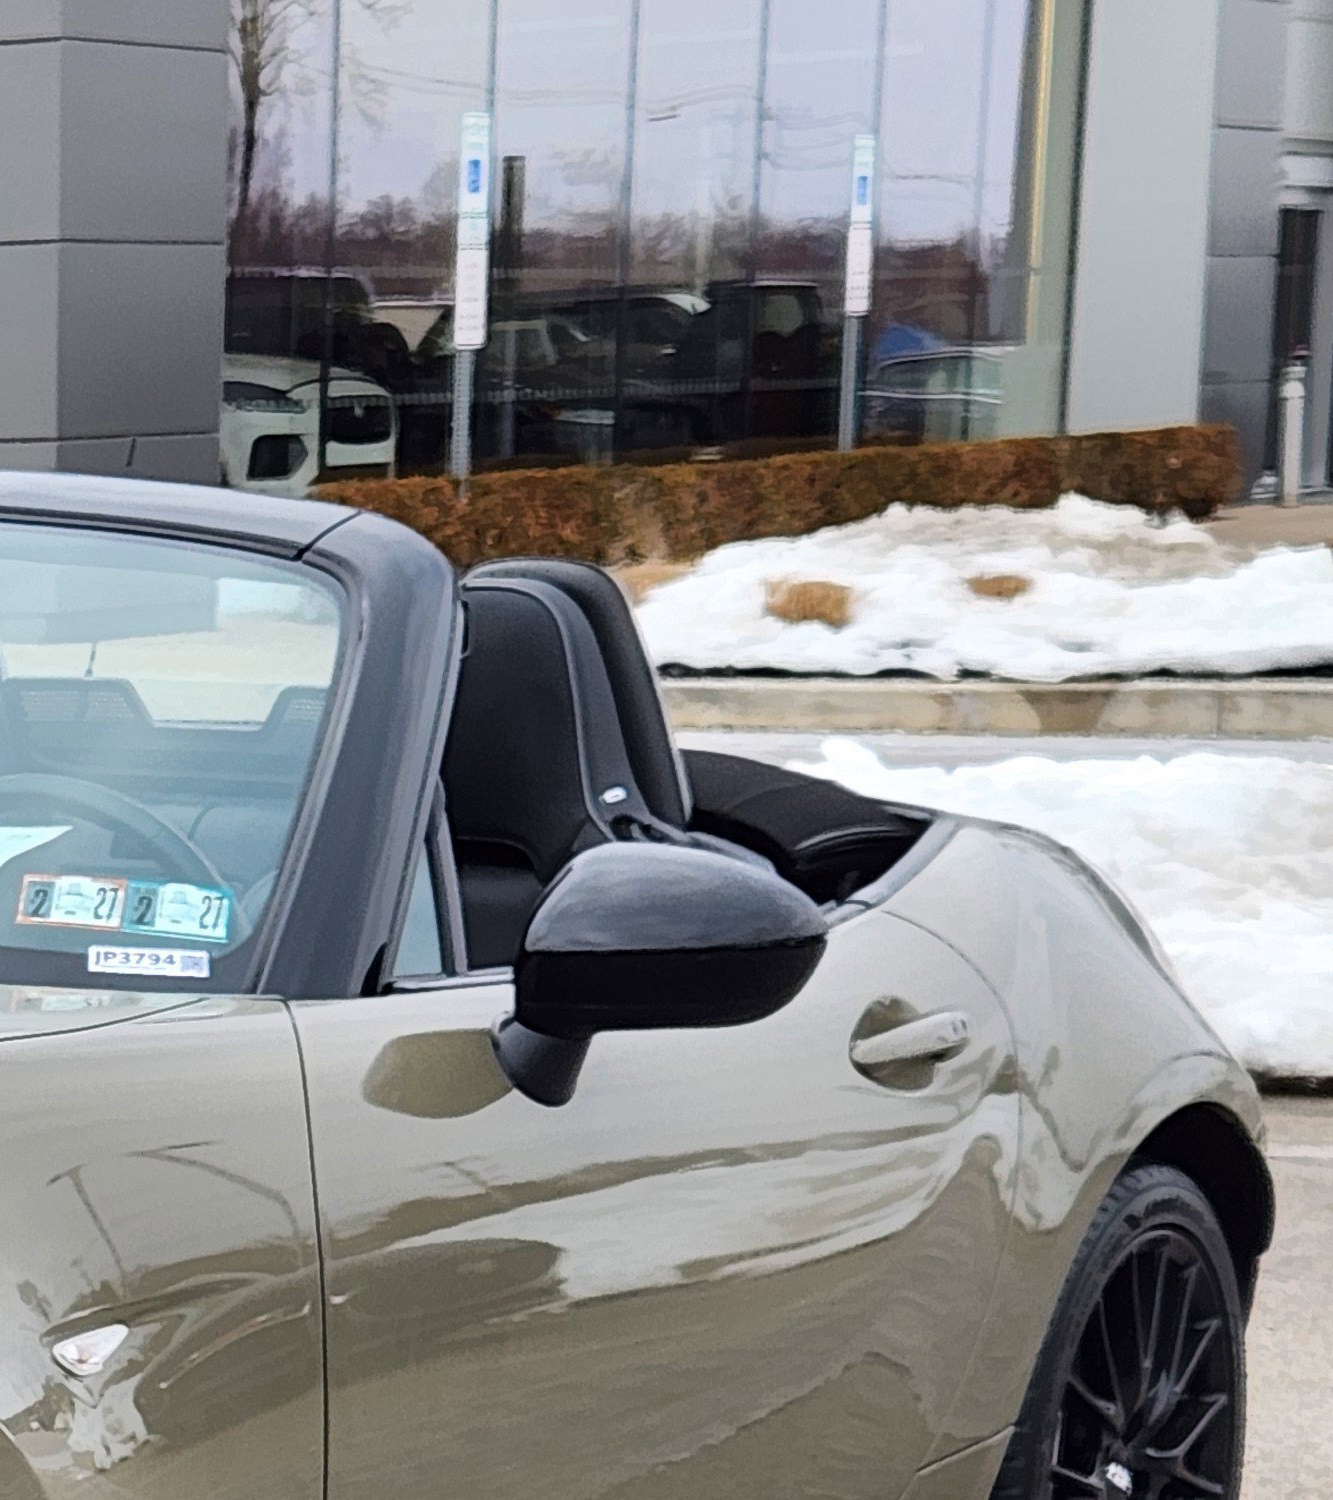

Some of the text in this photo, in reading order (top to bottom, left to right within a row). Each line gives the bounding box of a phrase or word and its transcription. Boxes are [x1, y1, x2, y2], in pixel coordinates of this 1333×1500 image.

[33, 887, 120, 922] 2 27
[136, 895, 224, 931] 2 27
[94, 951, 176, 966] JP3794
